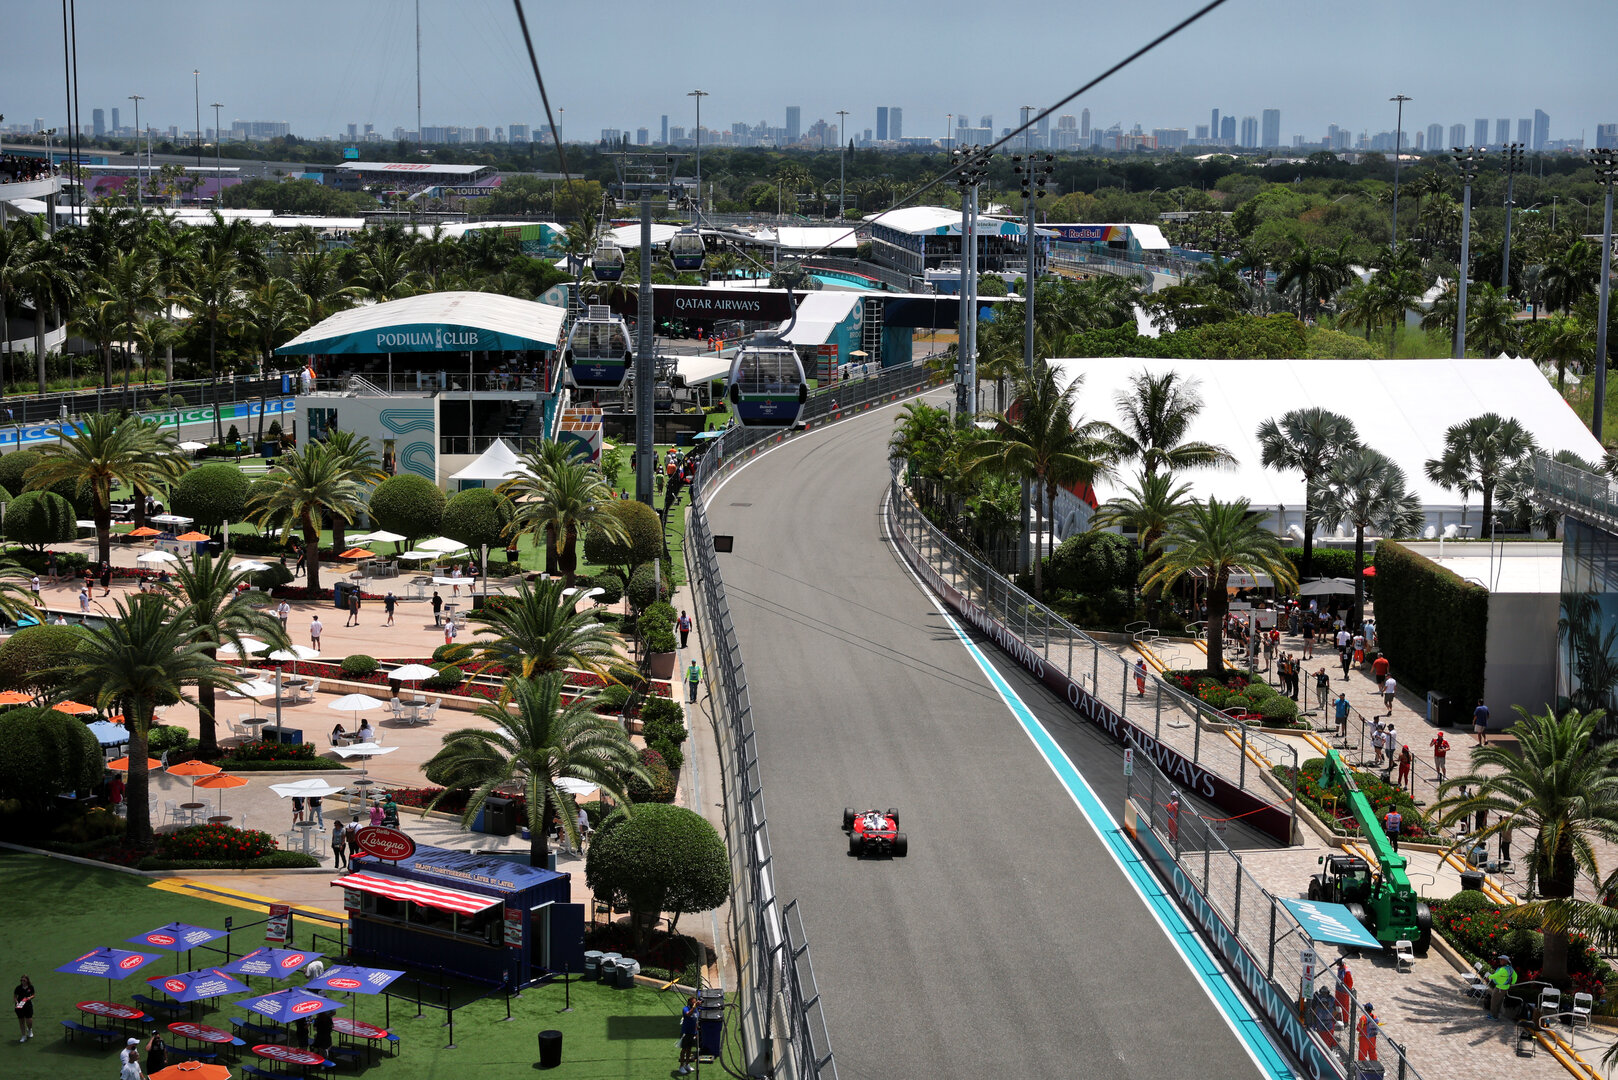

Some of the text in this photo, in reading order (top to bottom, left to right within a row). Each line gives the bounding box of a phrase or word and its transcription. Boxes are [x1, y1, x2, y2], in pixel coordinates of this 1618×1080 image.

[1069, 229, 1101, 238] Red Bull
[675, 298, 760, 311] QATAR AIRWAYS
[852, 300, 863, 330] 9
[376, 332, 479, 346] PODIUM CLUB
[960, 598, 1045, 678] QATAR AIRWAYS
[1067, 683, 1216, 798] QATAR AIRWAYS
[361, 832, 406, 851] Lasagna
[1173, 867, 1321, 1080] QATAR AIRWAYS
